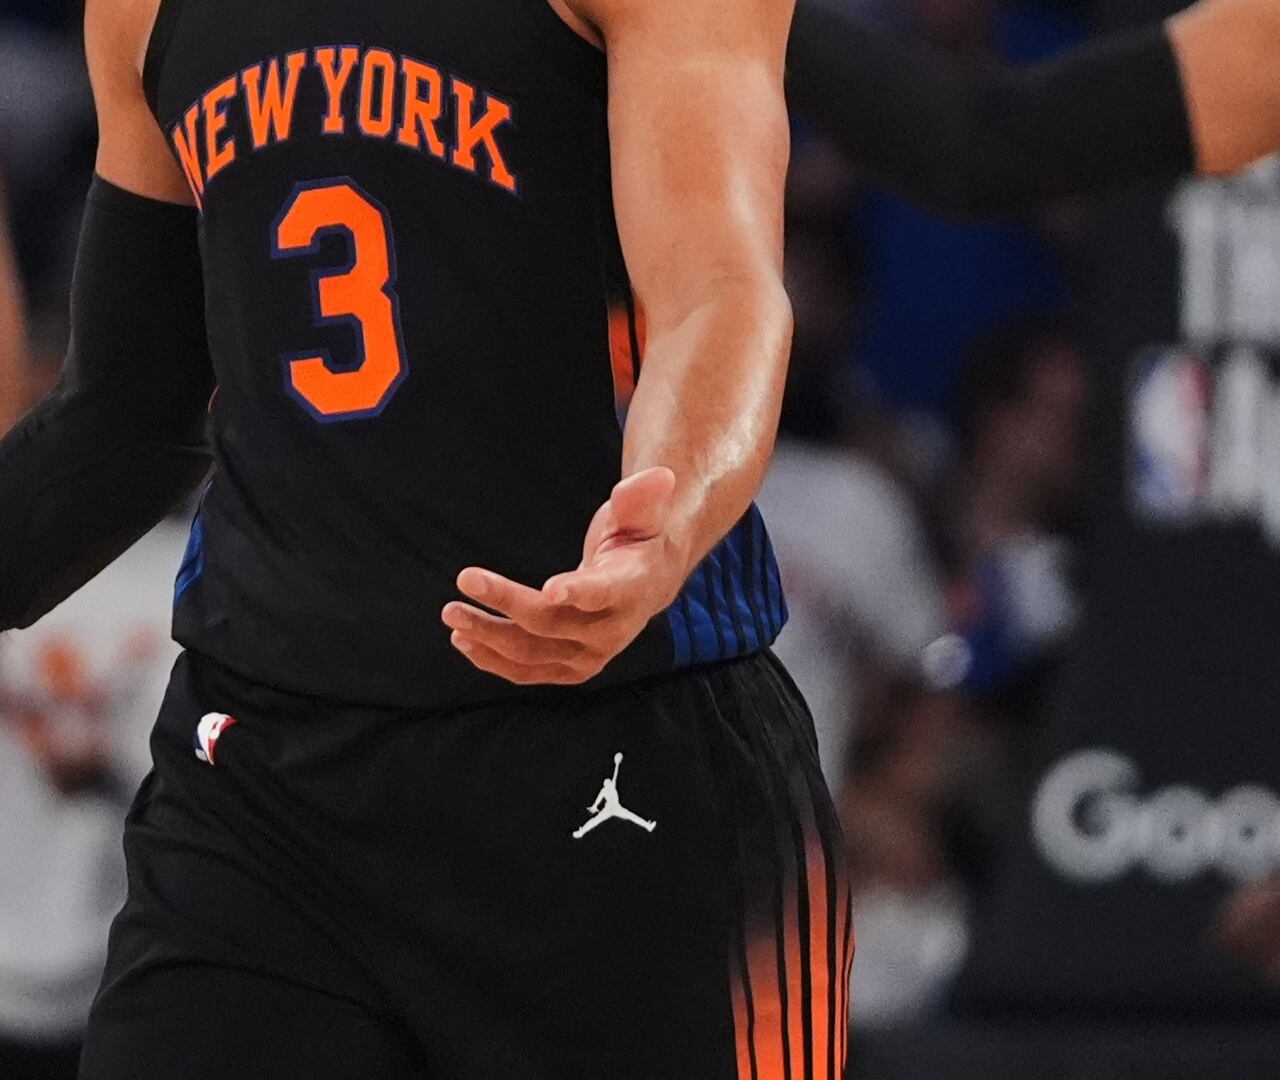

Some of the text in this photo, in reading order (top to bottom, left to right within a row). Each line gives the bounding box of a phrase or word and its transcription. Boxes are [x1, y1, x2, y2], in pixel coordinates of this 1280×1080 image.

[172, 44, 520, 213] NEW YORK
[271, 176, 409, 423] 3
